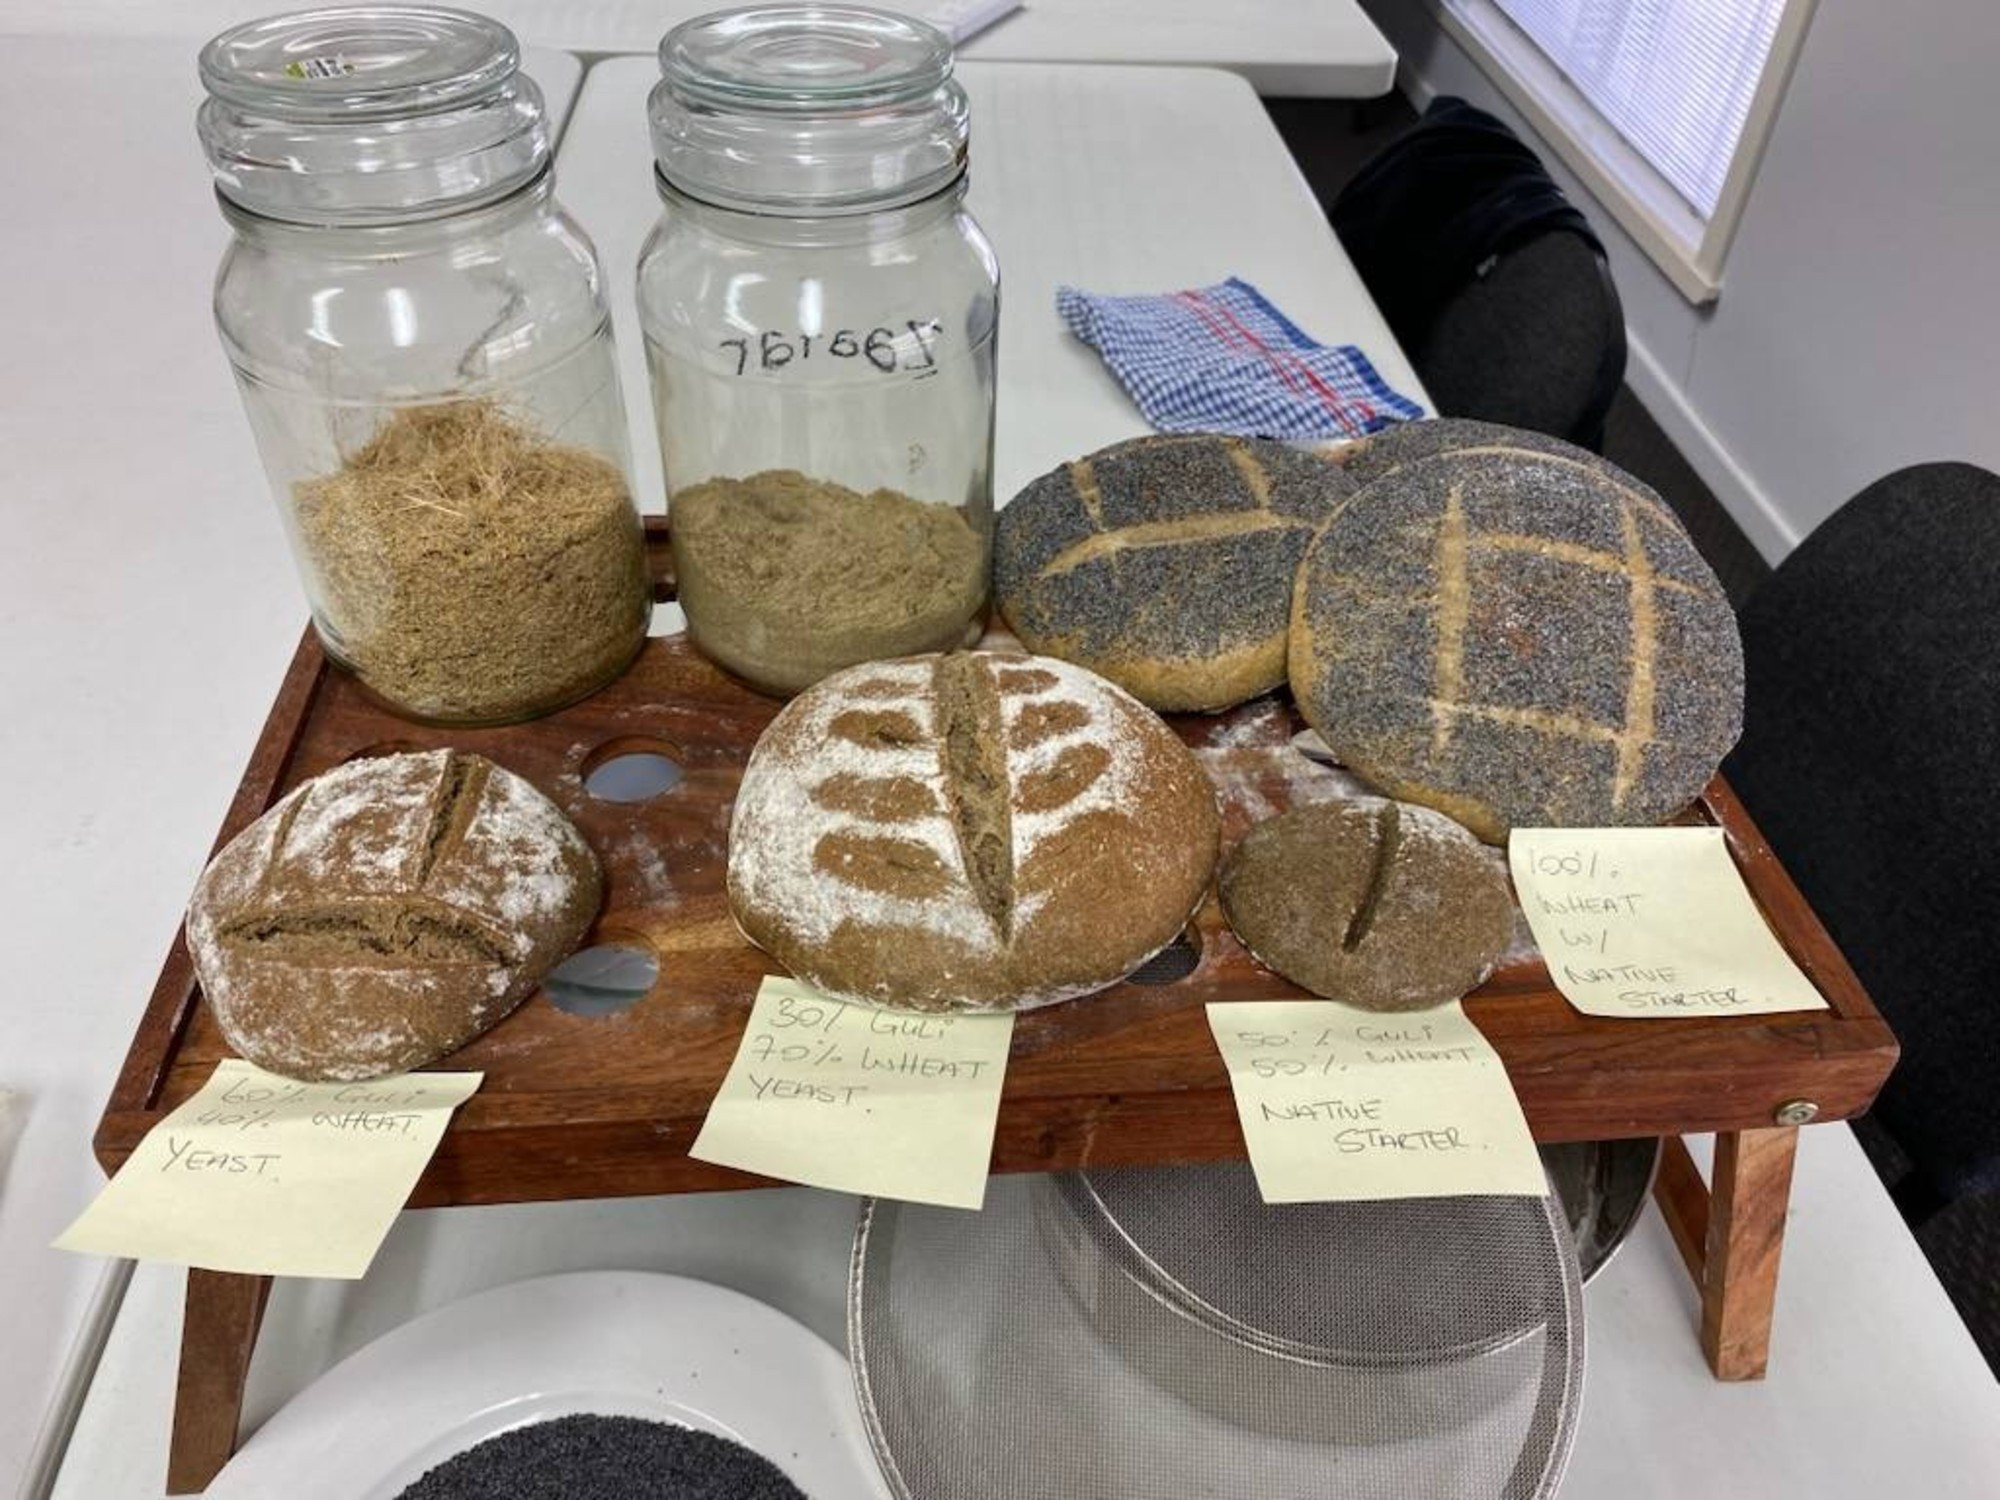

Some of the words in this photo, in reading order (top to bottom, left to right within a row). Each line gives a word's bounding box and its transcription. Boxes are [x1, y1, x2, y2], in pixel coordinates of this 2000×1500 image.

[751, 1034, 843, 1066] 70%
[861, 1046, 990, 1080] WHEAT
[1261, 1099, 1382, 1121] NATIVE
